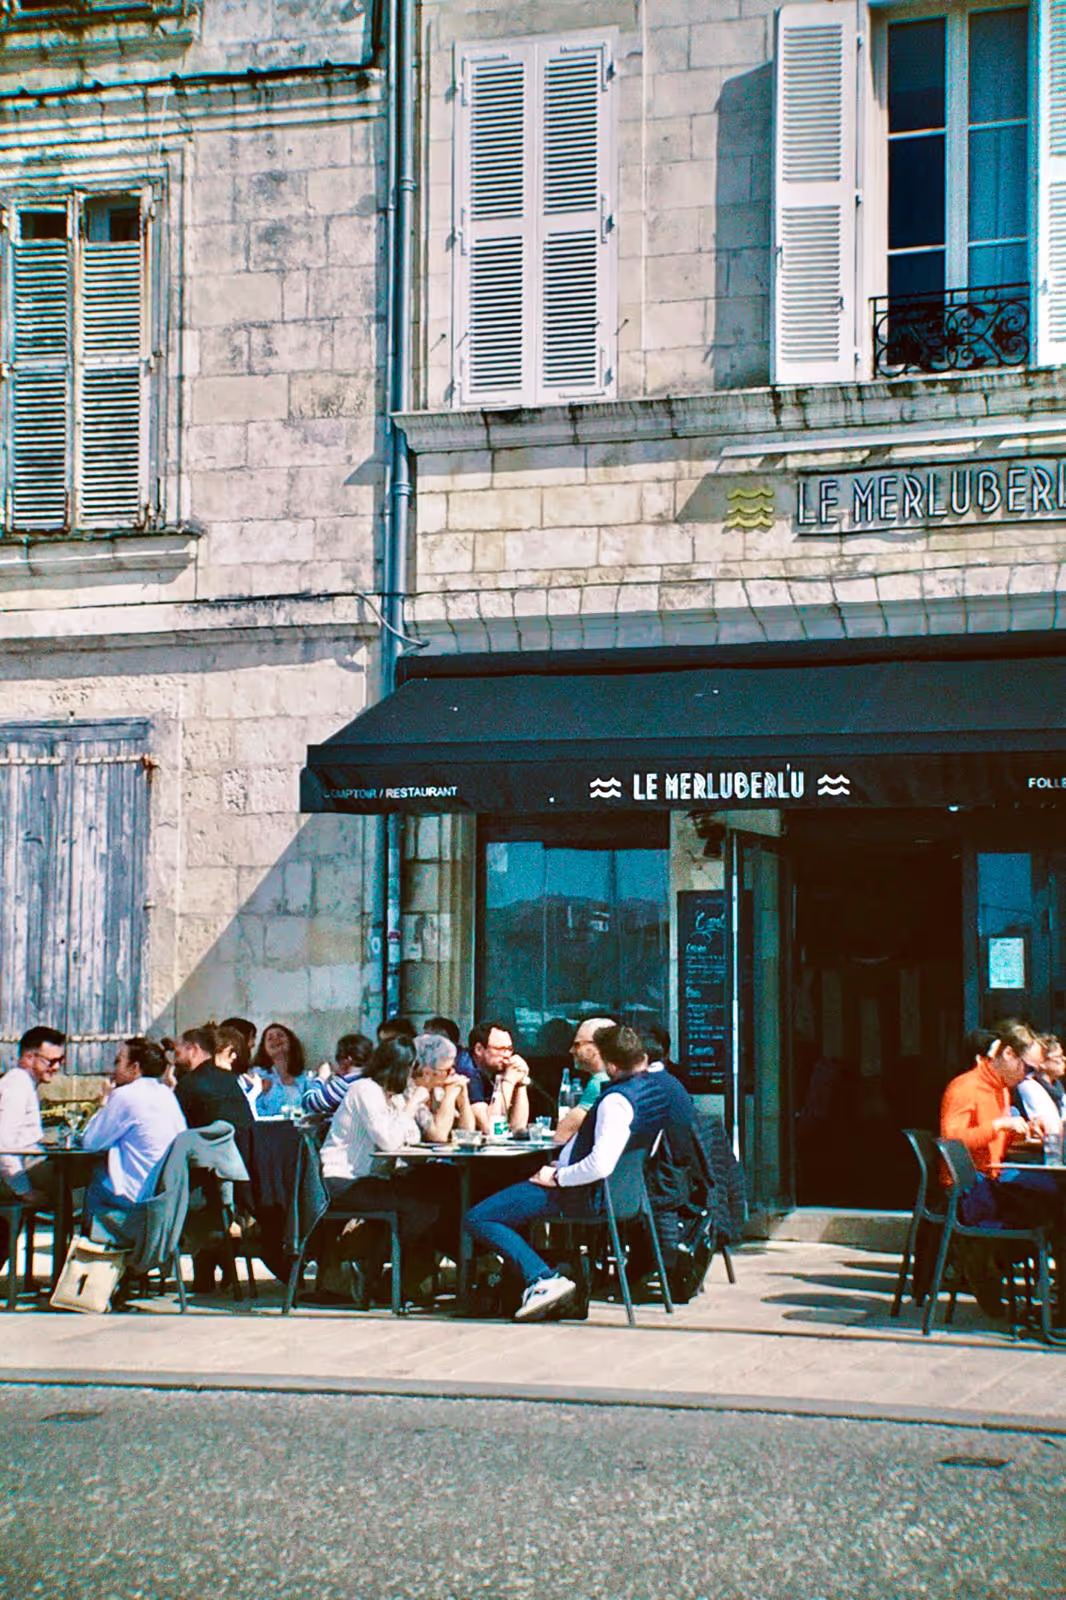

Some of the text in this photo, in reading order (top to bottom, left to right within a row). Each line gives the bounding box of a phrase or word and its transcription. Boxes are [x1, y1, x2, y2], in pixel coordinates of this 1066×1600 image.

[797, 480, 838, 525] LE
[385, 786, 458, 798] RESTAURANT
[633, 771, 804, 800] LE MERLUBERLU
